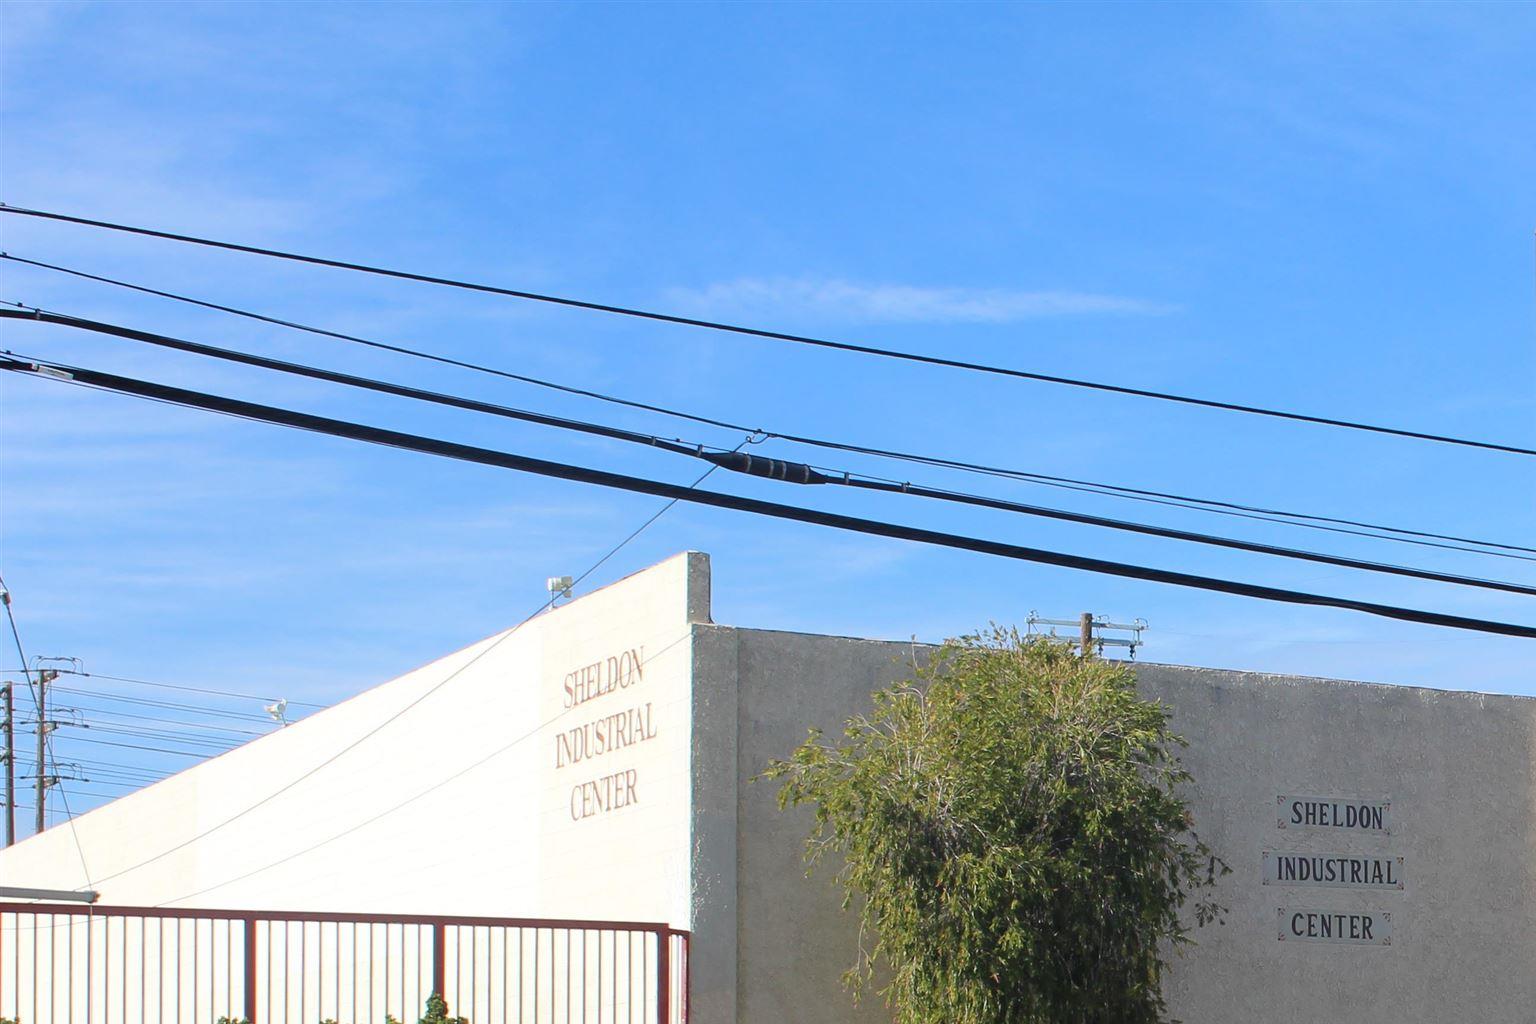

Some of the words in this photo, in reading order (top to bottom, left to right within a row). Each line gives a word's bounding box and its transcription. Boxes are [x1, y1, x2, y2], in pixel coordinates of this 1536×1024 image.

[564, 645, 644, 708] SHELDON
[555, 702, 657, 769] INDUSTRIAL
[571, 768, 638, 821] CENTER
[1291, 801, 1383, 829] SHELDON
[1277, 856, 1397, 884] INDUSTRIAL
[1291, 912, 1373, 940] CENTER
